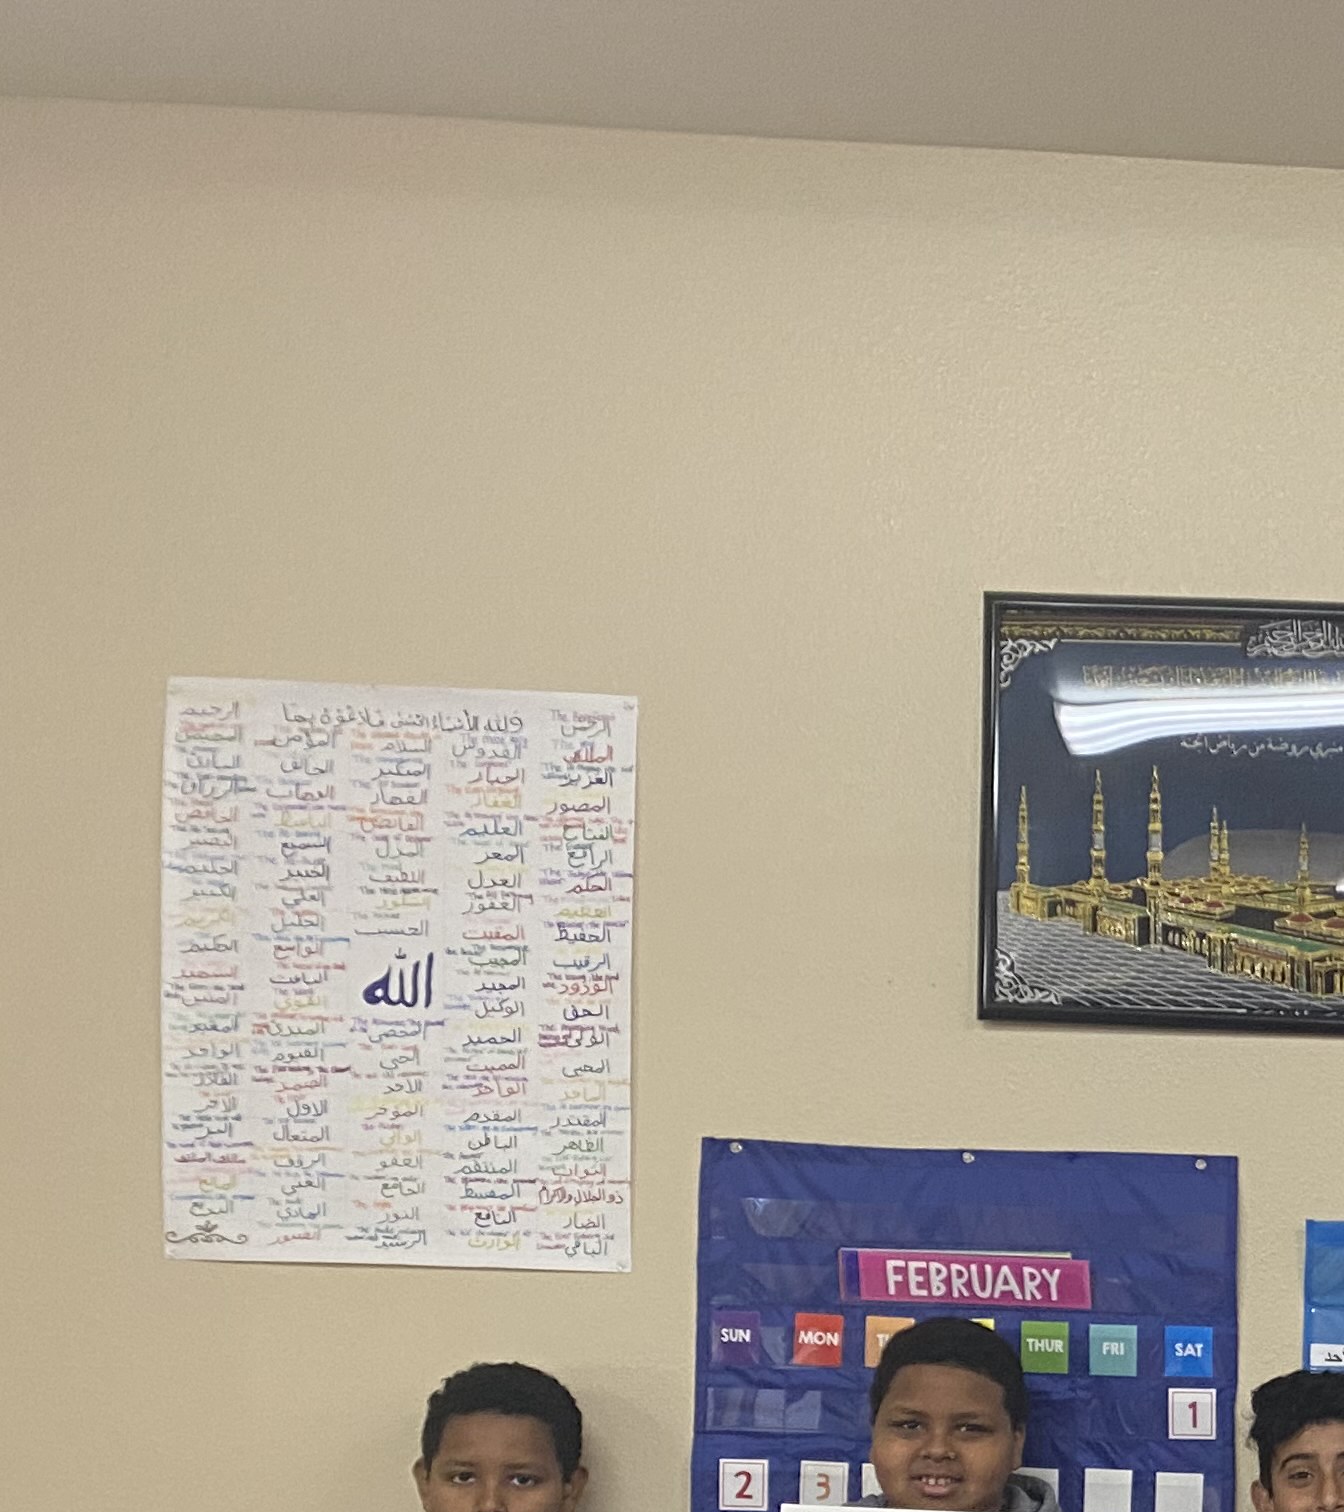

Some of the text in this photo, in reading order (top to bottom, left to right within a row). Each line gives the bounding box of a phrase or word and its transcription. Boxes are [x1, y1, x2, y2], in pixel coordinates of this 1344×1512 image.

[362, 948, 434, 1009] الله
[885, 1259, 1062, 1302] FEBRUARY
[720, 1327, 1204, 1357] SUN MON THUR FRI SAT
[1187, 1401, 1199, 1429] 1
[734, 1471, 831, 1500] 2 3
